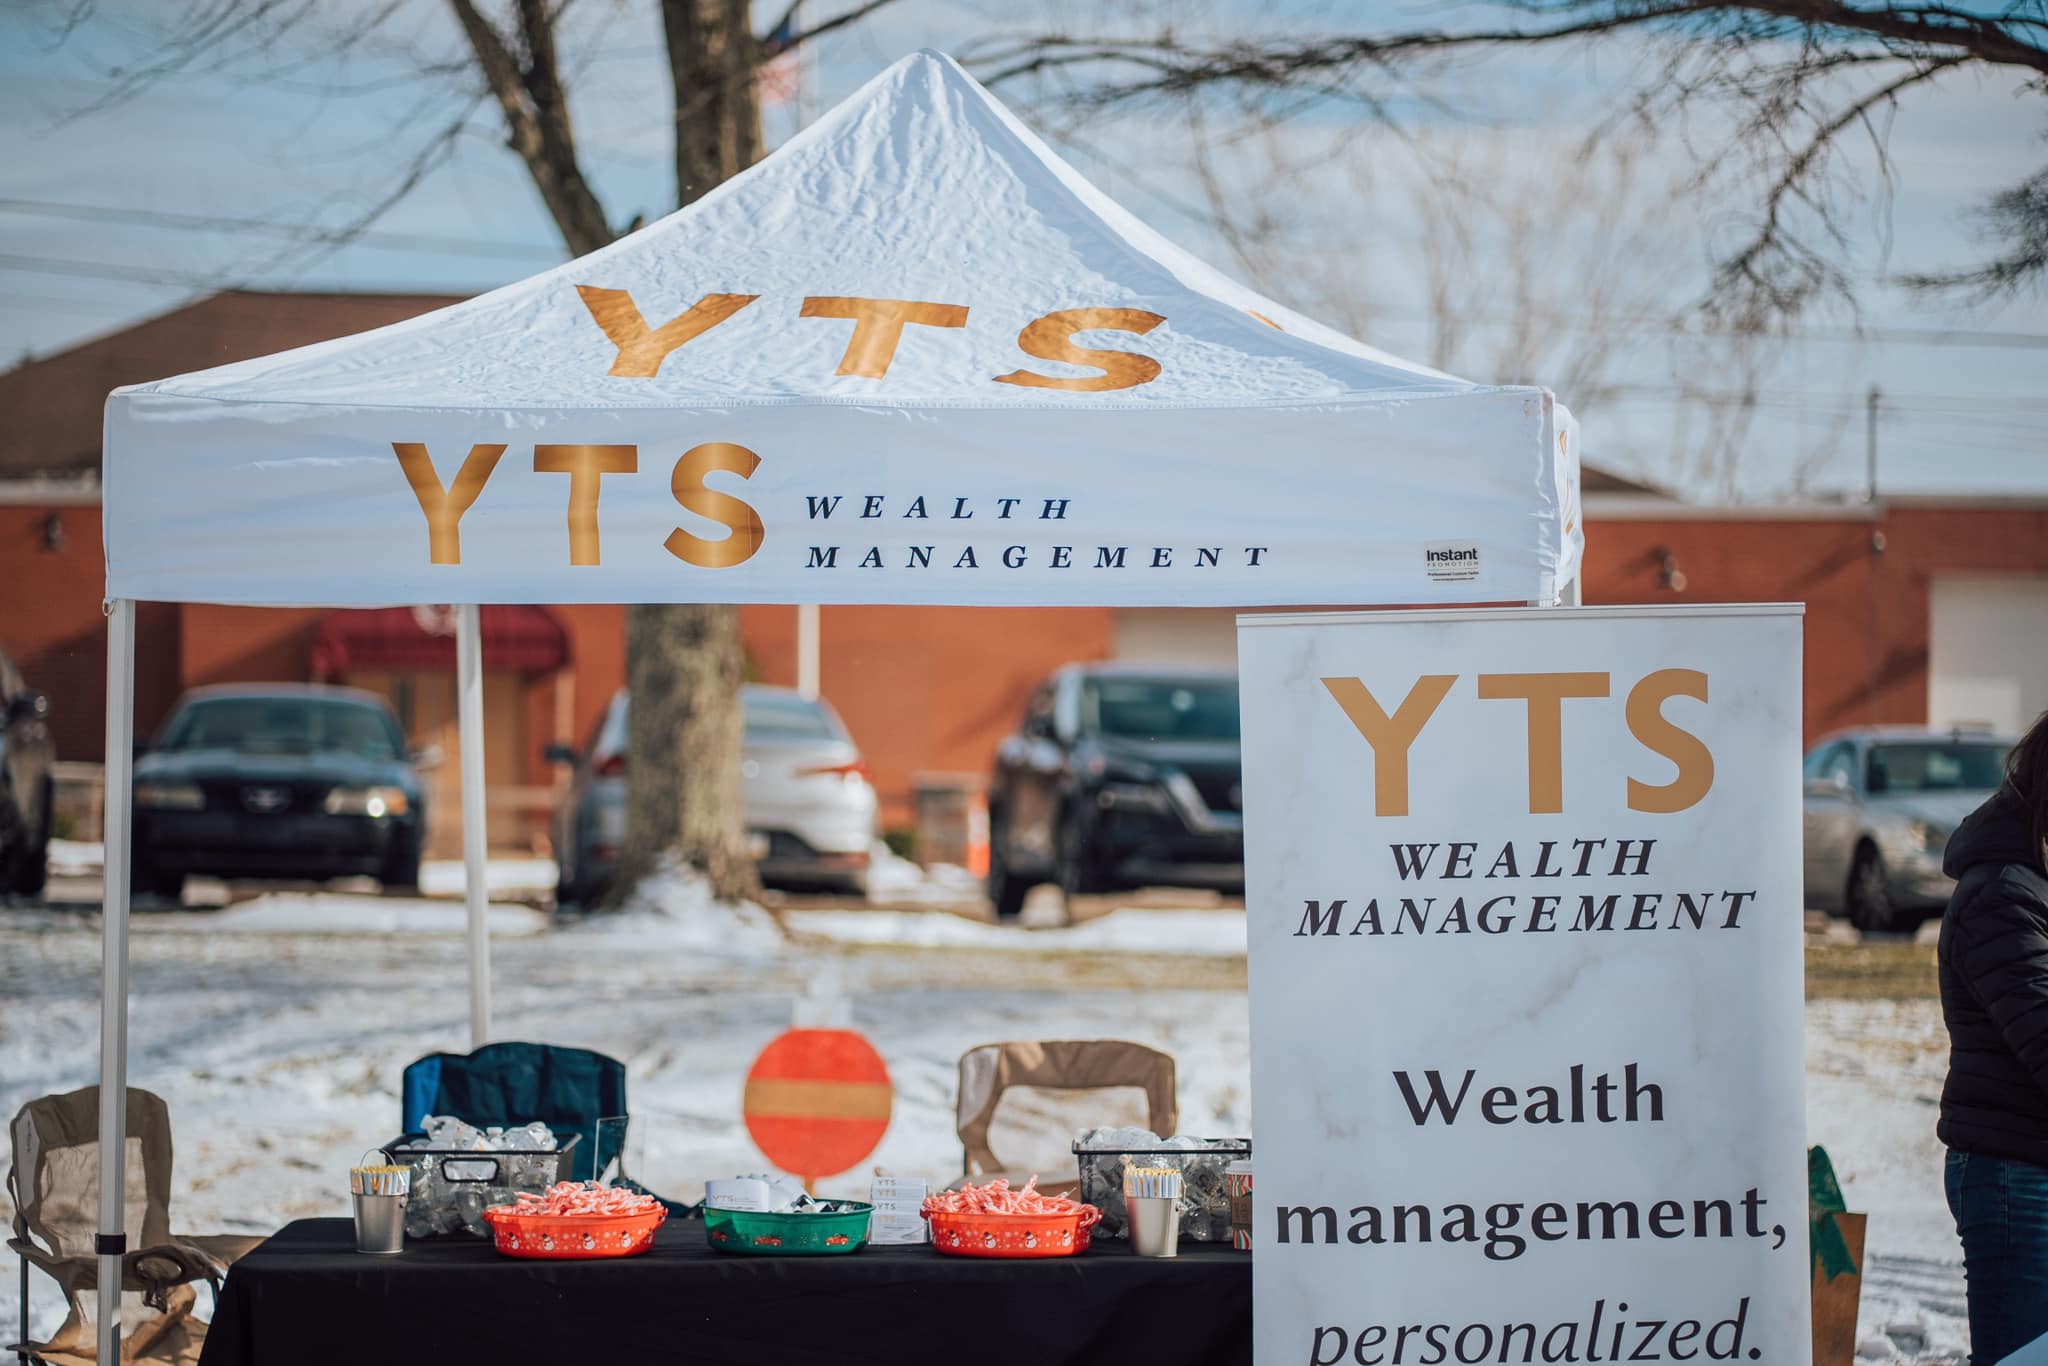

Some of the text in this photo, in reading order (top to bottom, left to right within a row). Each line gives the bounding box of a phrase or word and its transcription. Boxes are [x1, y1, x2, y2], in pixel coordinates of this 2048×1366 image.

[576, 285, 1165, 392] YTS
[392, 442, 765, 568] YTS
[804, 495, 1073, 520] WEALTH
[804, 545, 1270, 570] MANAGEMENT
[1427, 548, 1478, 561] Instant
[1322, 668, 1714, 817] YTS
[1389, 837, 1659, 881] WEALTH
[1293, 889, 1758, 938] MANAGEMENT
[1391, 1062, 1665, 1127] Wealth
[1276, 1187, 1787, 1261] management,
[1308, 1295, 1763, 1366] personalized.
